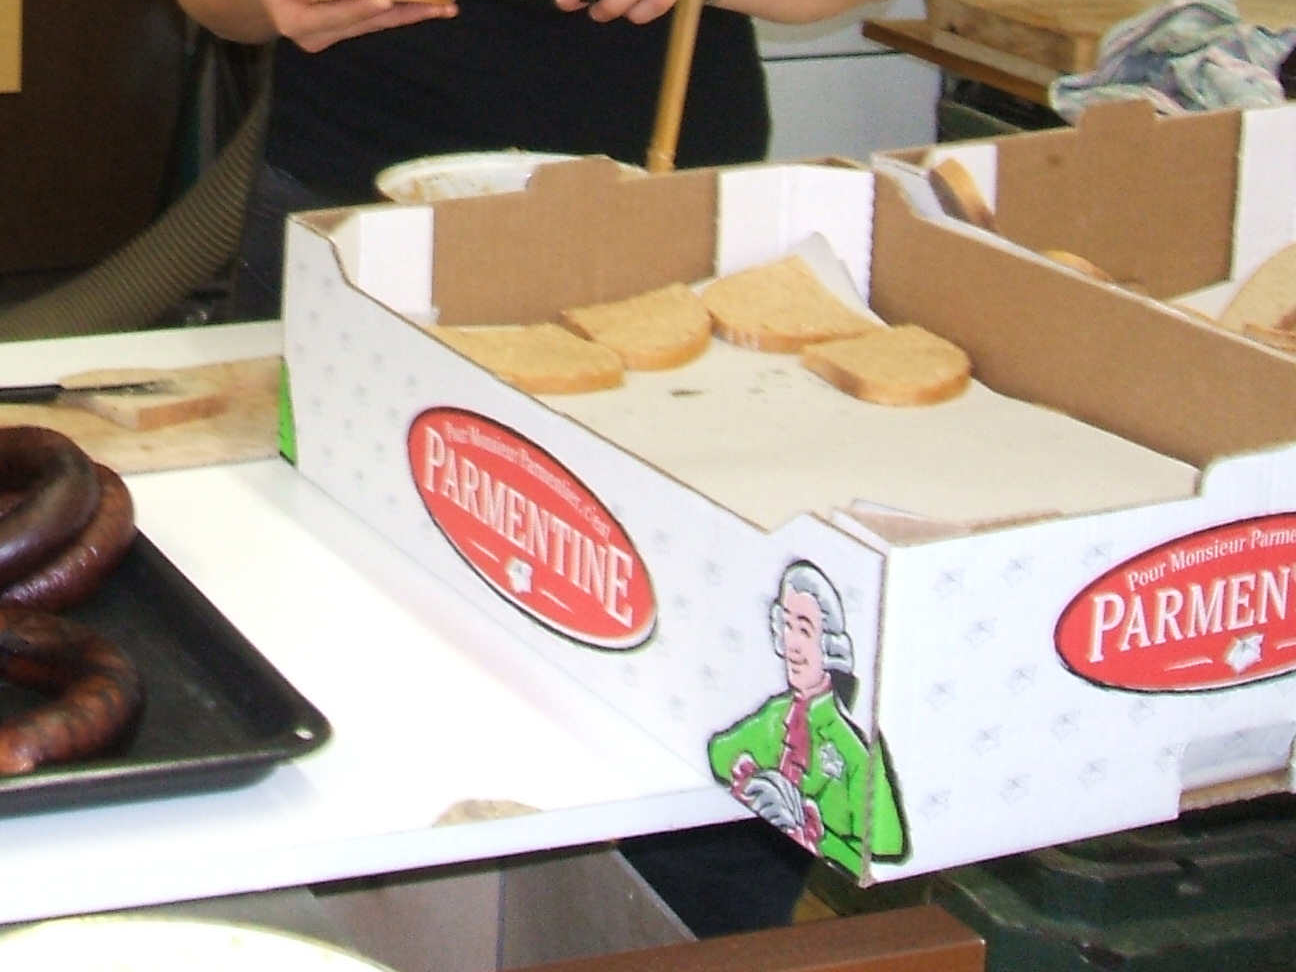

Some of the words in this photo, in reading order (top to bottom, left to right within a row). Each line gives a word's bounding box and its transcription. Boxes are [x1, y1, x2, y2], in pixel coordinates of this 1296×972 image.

[422, 424, 634, 629] PARMENTINE
[1126, 561, 1167, 592] Pour
[1169, 535, 1247, 573] Monsieur
[1088, 561, 1296, 664] PARMEN
